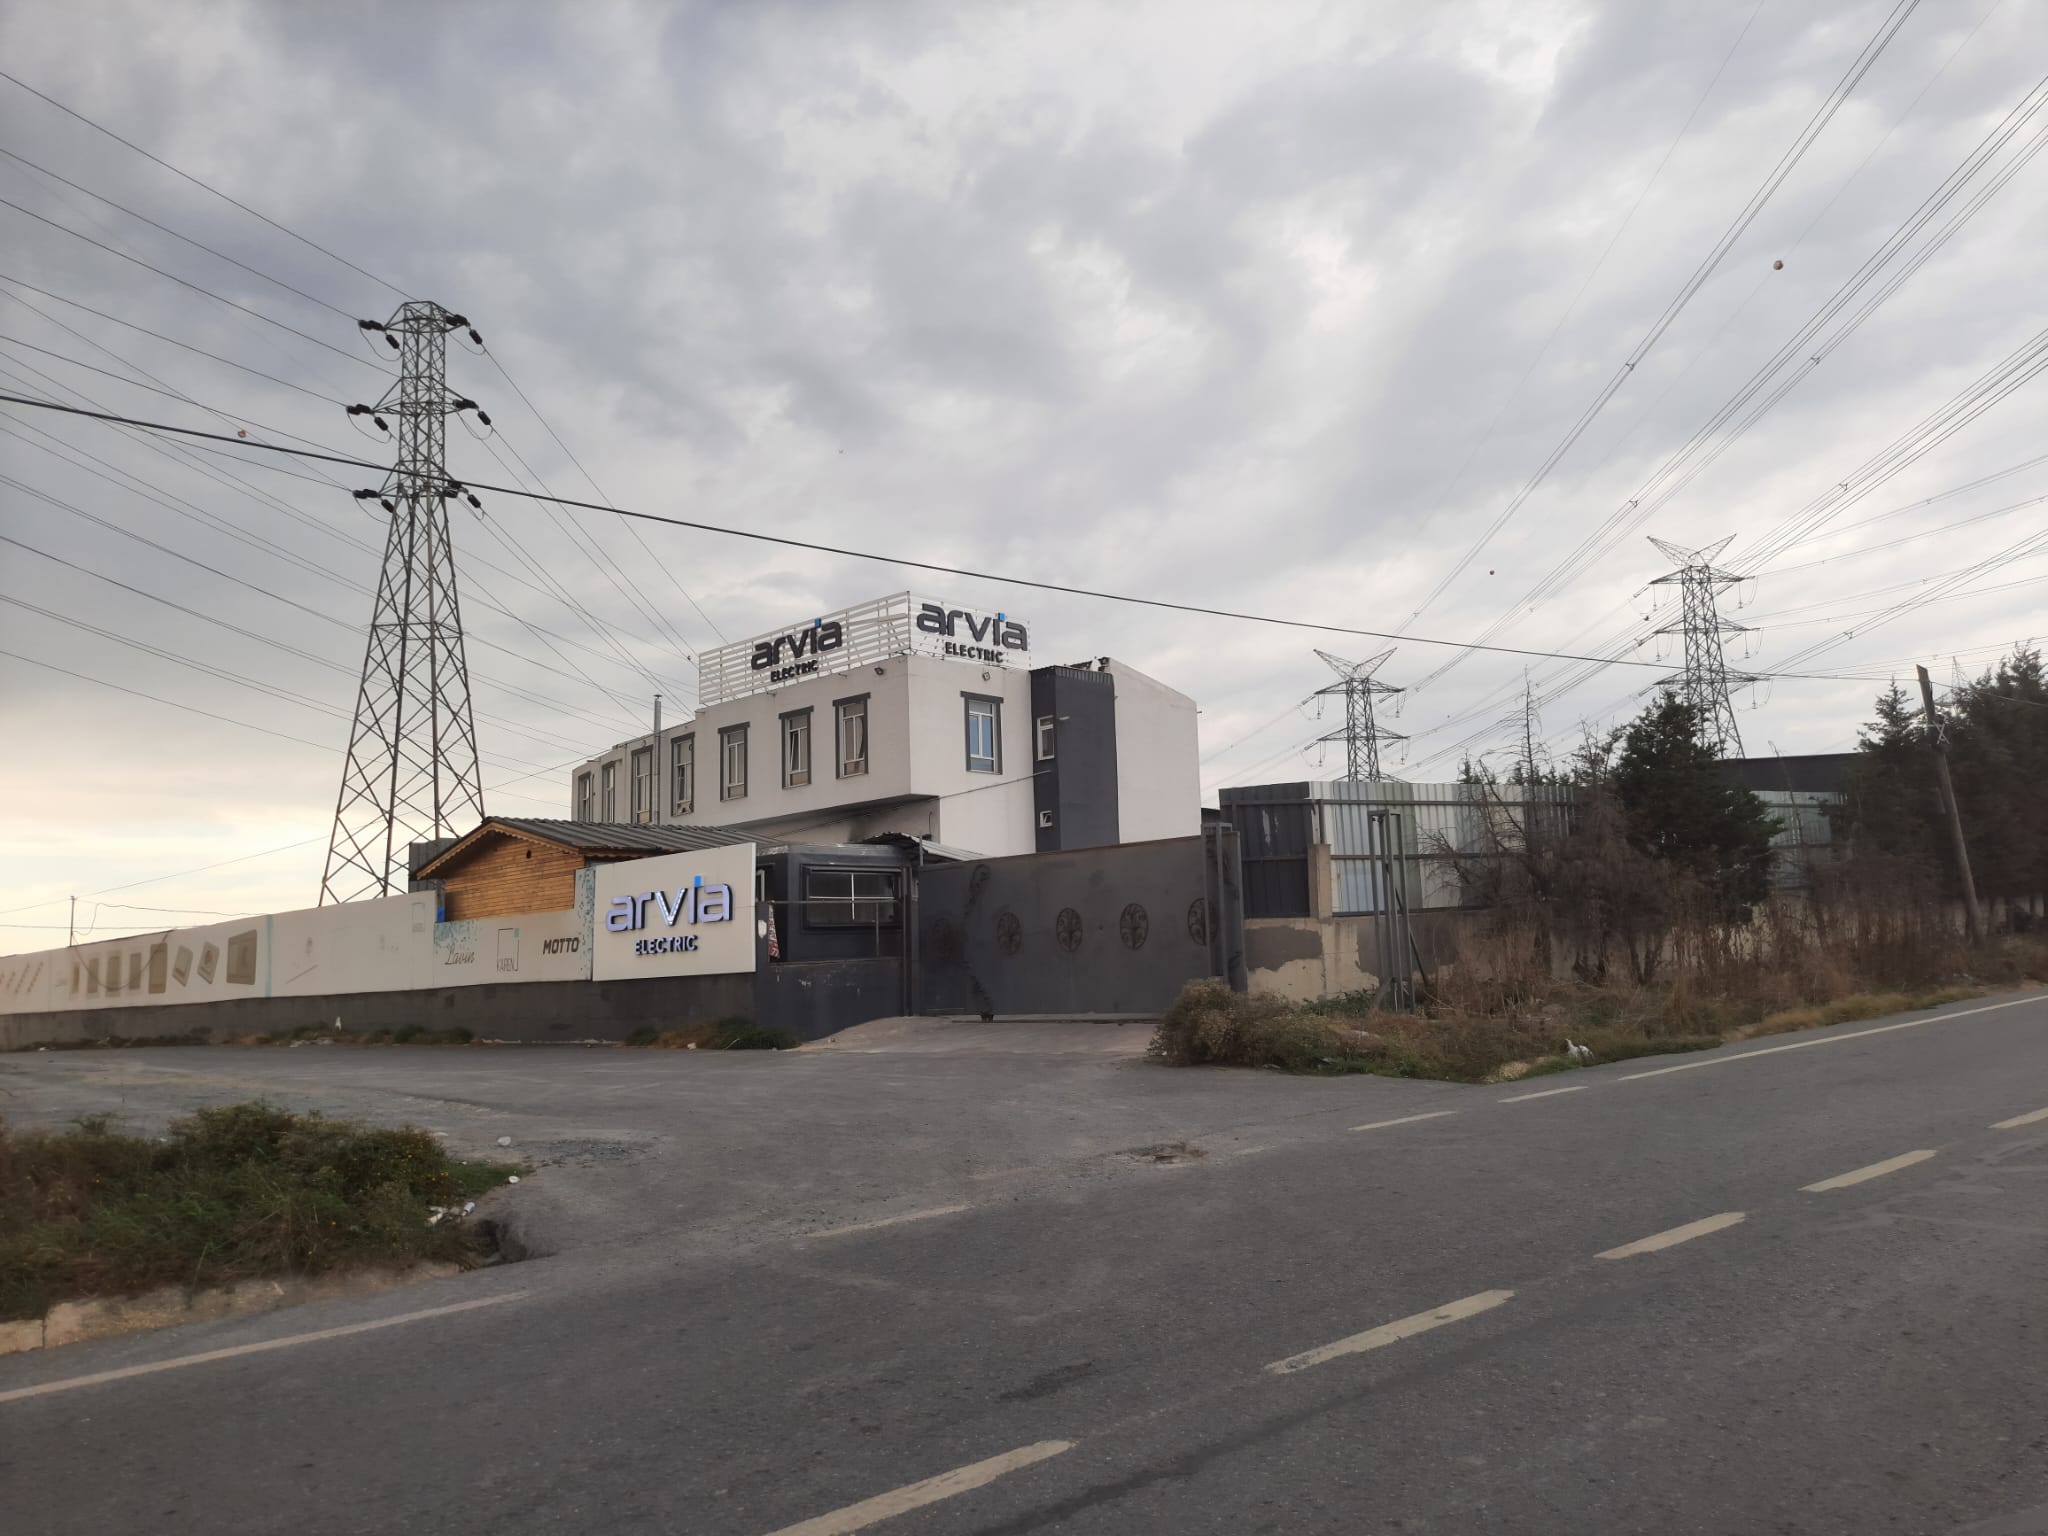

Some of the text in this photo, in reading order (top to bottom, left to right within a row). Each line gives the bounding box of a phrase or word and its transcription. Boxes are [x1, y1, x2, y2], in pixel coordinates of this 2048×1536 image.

[917, 603, 1028, 651] arvia
[751, 617, 842, 670] arvia
[945, 641, 1003, 663] ELECTRIC
[770, 660, 818, 682] ELECTRIC
[605, 875, 733, 932] arvia
[543, 937, 579, 954] MOTTO
[635, 935, 698, 955] ELECTRIC
